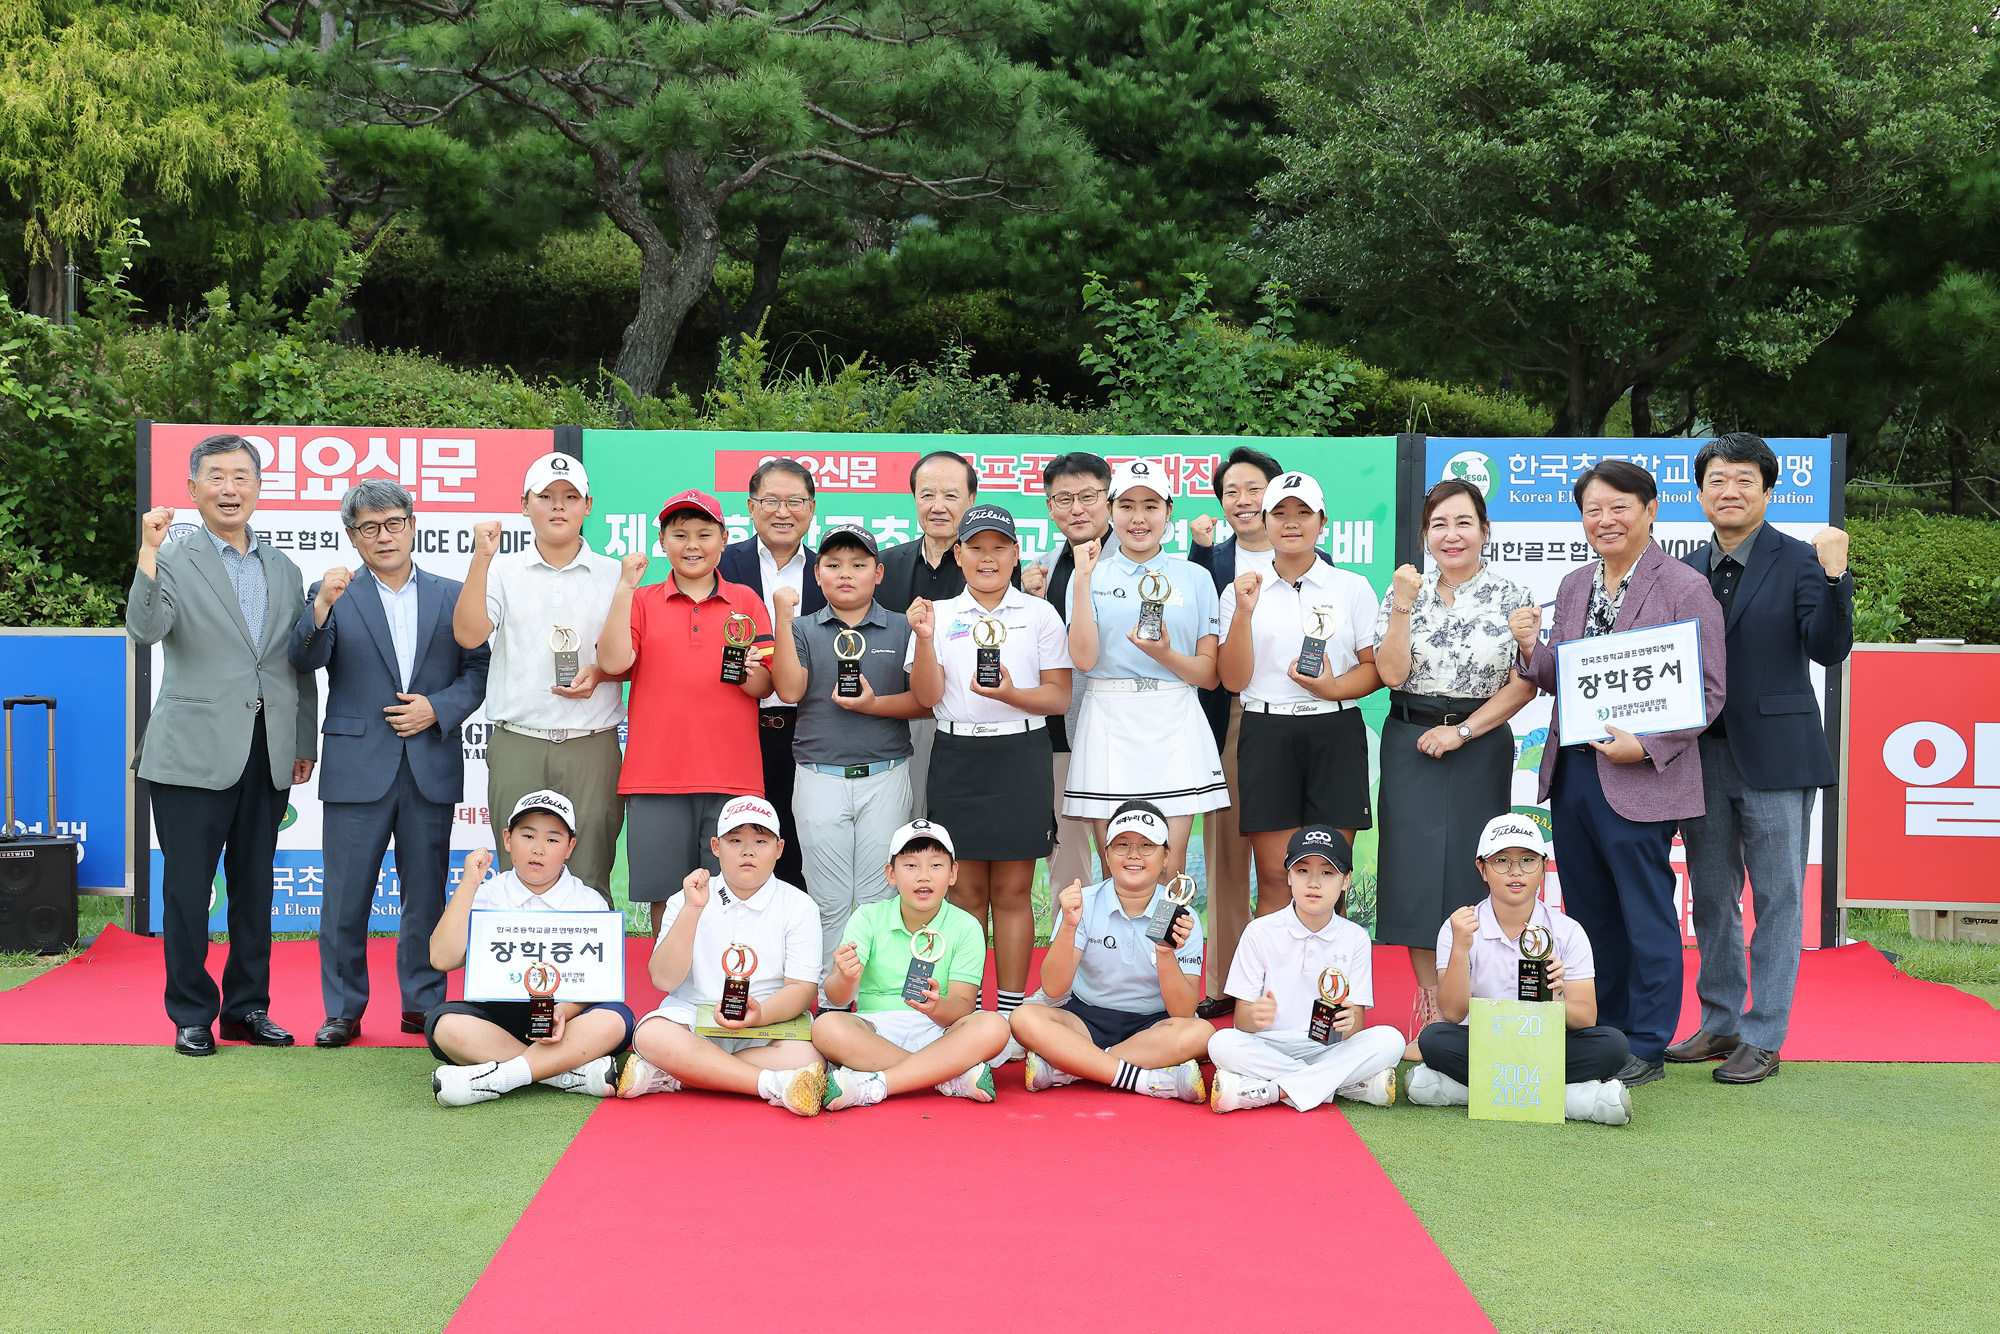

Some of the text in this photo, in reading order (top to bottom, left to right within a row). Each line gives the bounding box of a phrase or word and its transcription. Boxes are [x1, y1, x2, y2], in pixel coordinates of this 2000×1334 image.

[242, 435, 478, 503] 일요신문
[1508, 490, 1552, 503] Korea
[965, 509, 1011, 525] Titleist
[1577, 659, 1682, 700] 장학증서
[520, 795, 569, 814] Titleist
[724, 802, 772, 820] Titleist
[1490, 823, 1534, 841] Titleist
[489, 941, 604, 964] 장학증서
[1492, 1085, 1541, 1107] 2024
